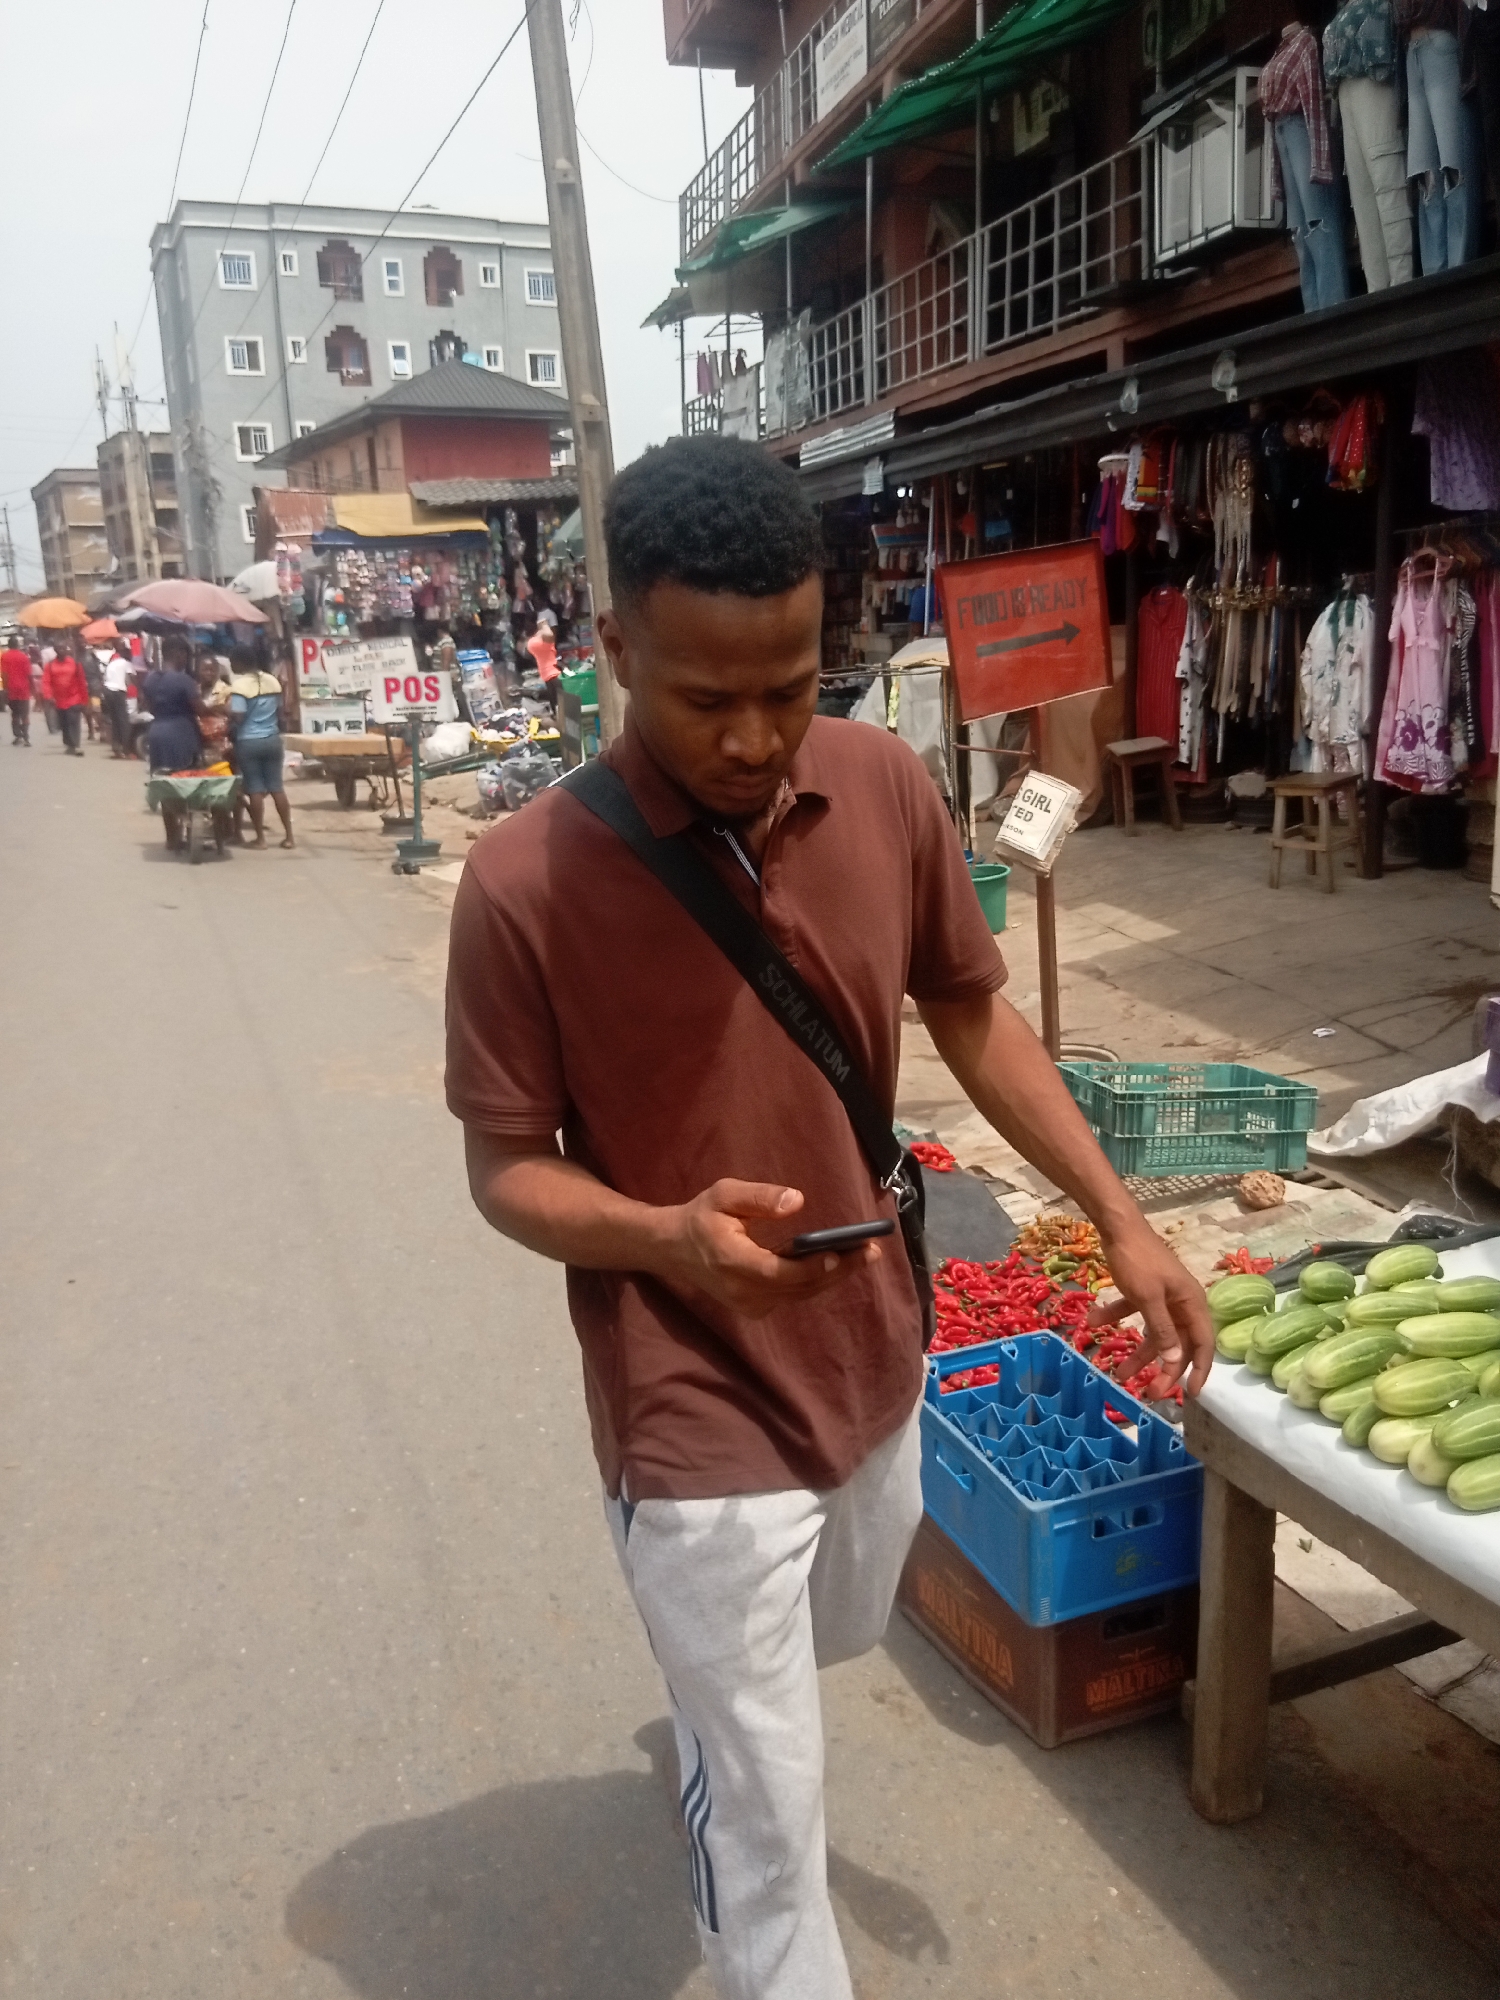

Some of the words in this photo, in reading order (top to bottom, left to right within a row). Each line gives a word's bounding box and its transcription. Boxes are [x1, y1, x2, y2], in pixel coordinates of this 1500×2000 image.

[957, 590, 1009, 629] FOOD
[1011, 586, 1026, 618] IS
[1030, 577, 1088, 615] READY
[384, 676, 440, 704] POS
[1022, 788, 1051, 813] GIRL
